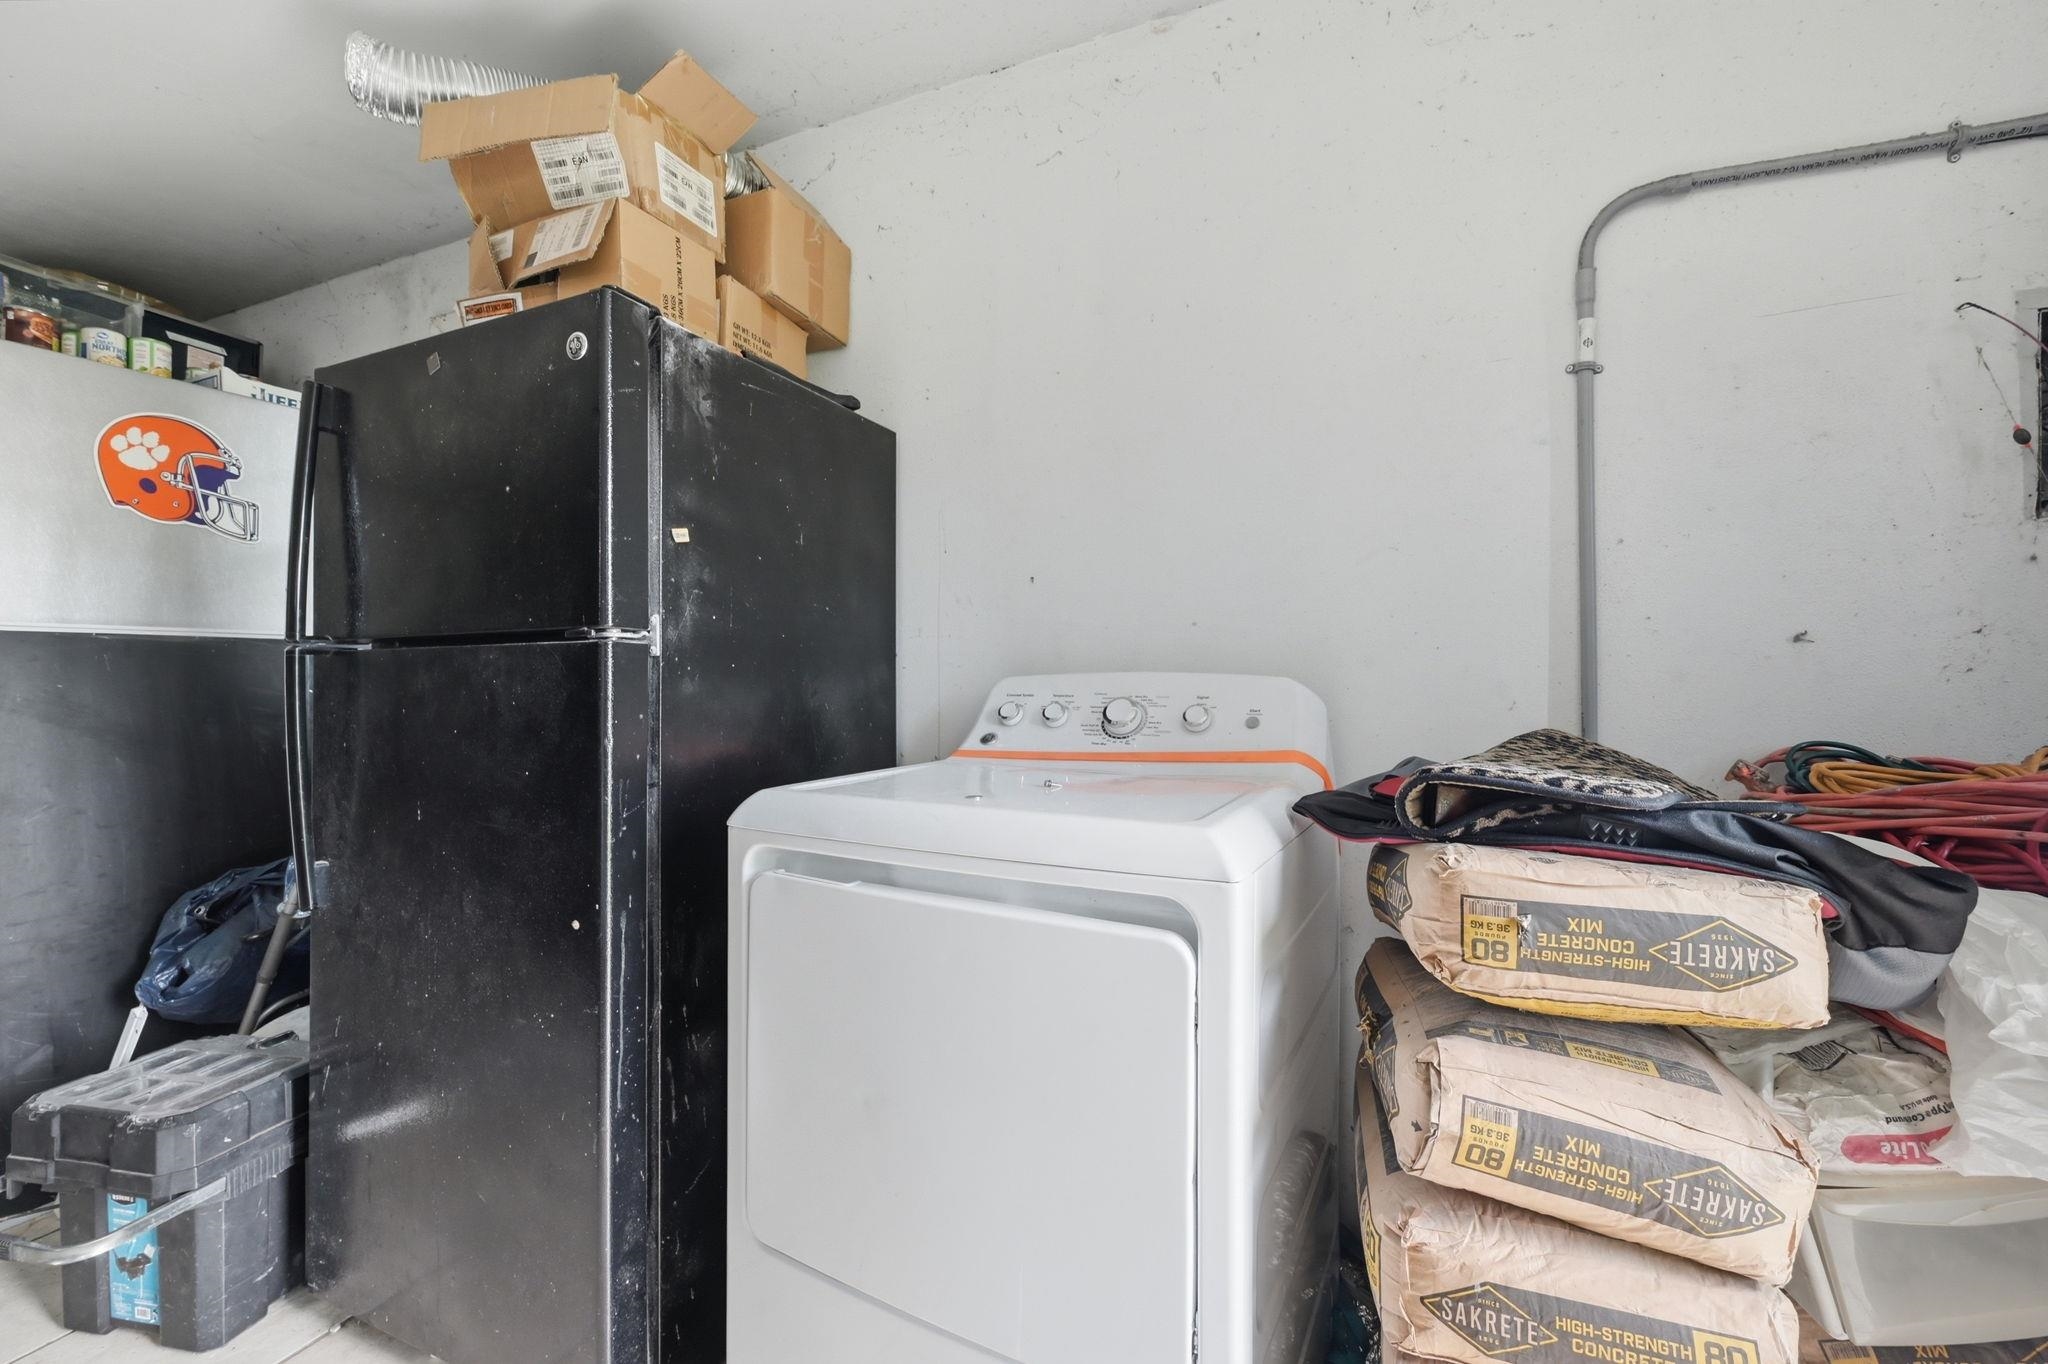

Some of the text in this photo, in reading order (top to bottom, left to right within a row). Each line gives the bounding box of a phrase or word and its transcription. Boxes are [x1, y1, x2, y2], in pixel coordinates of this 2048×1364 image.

[1469, 920, 1511, 933] 36.3 KG
[1567, 916, 1603, 935] MIX
[1471, 938, 1510, 964] 80
[1536, 932, 1635, 954] CONCRETE
[1520, 947, 1651, 972] HIGH-STRENGTH
[1667, 939, 1776, 974] SAKRETE
[1572, 1045, 1592, 1054] MIX
[1470, 1124, 1510, 1142] 36.3 KG
[1464, 1143, 1506, 1171] 80
[1565, 1134, 1601, 1158] MIX
[1880, 1141, 1920, 1159] Lite
[1532, 1145, 1631, 1184] CONCRETE
[1514, 1159, 1644, 1205] HIGH-STRENGTH
[1661, 1179, 1767, 1227] SAKRETE
[1440, 1295, 1540, 1346] SAKRETE
[1555, 1316, 1695, 1360] HIGH-STRENGTH
[1914, 1345, 1950, 1358] MIX
